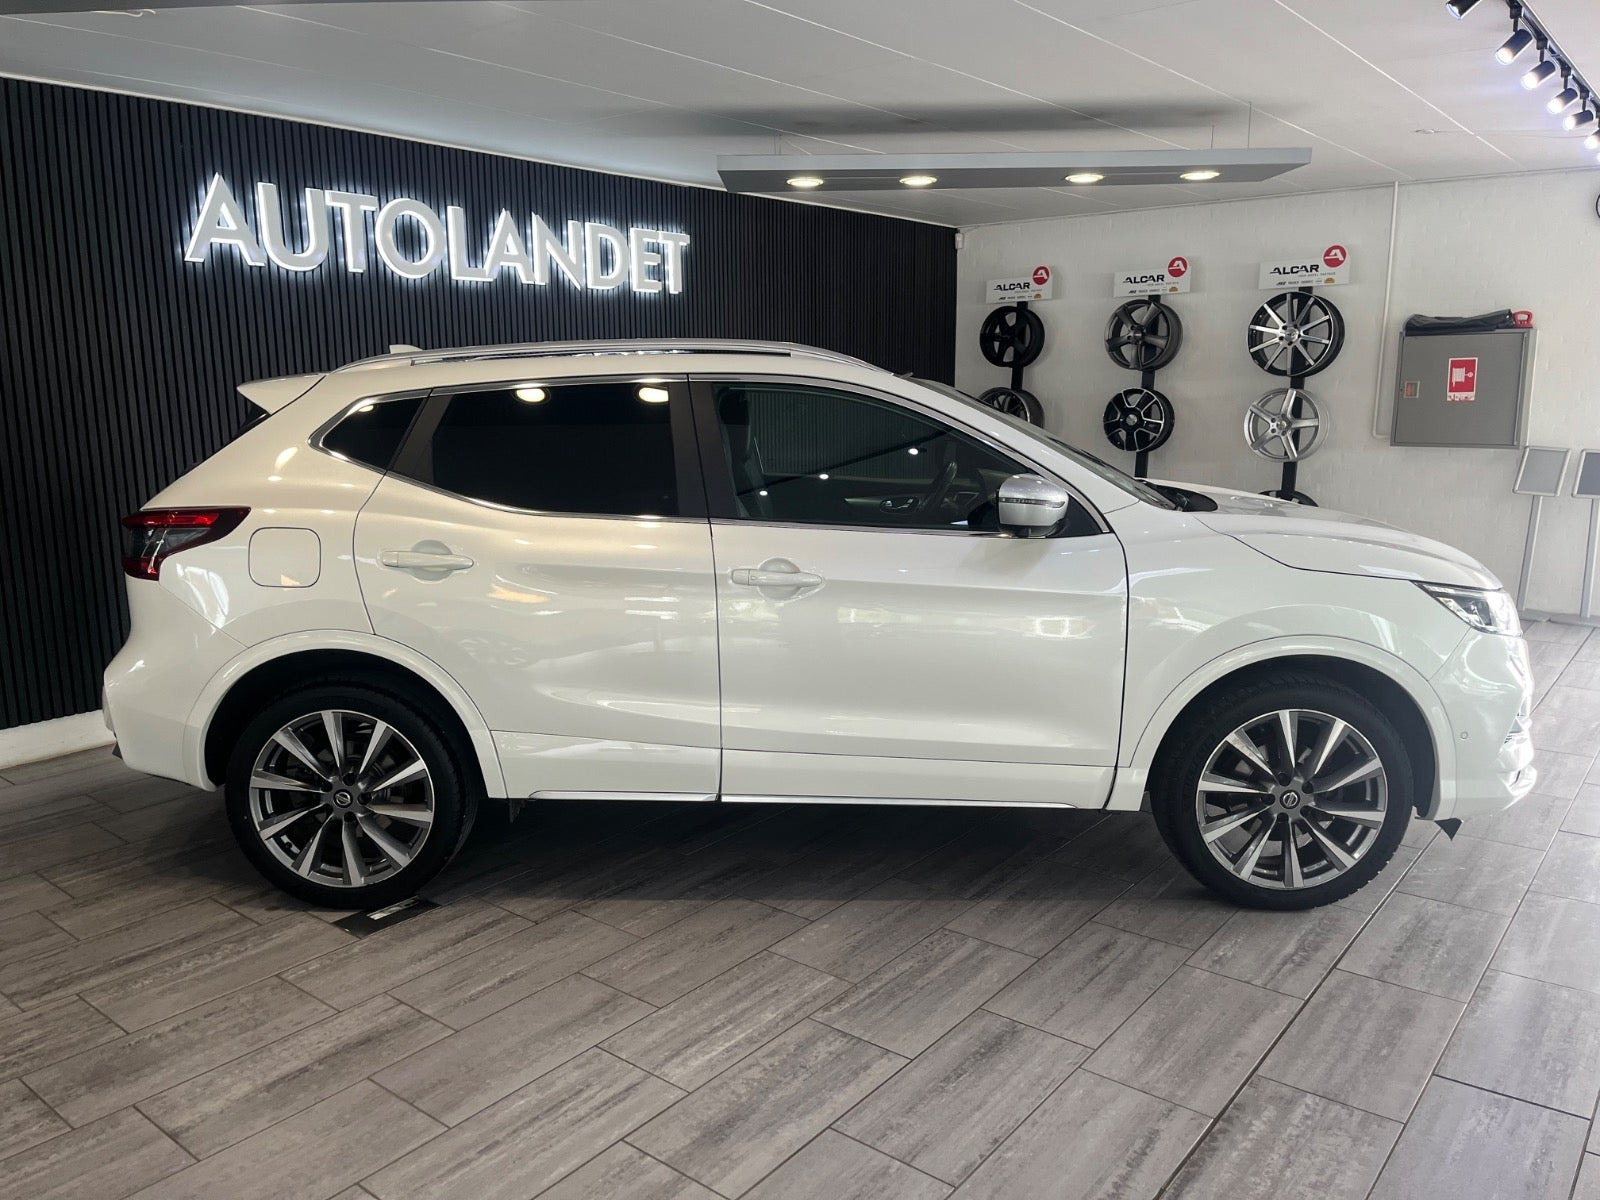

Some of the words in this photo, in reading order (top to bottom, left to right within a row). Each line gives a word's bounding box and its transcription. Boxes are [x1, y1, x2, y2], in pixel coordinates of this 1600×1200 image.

[184, 172, 690, 295] AUTOLANDET
[1269, 264, 1320, 275] ALCAR
[1122, 274, 1165, 284] ALCAR
[993, 282, 1031, 292] ALCAR
